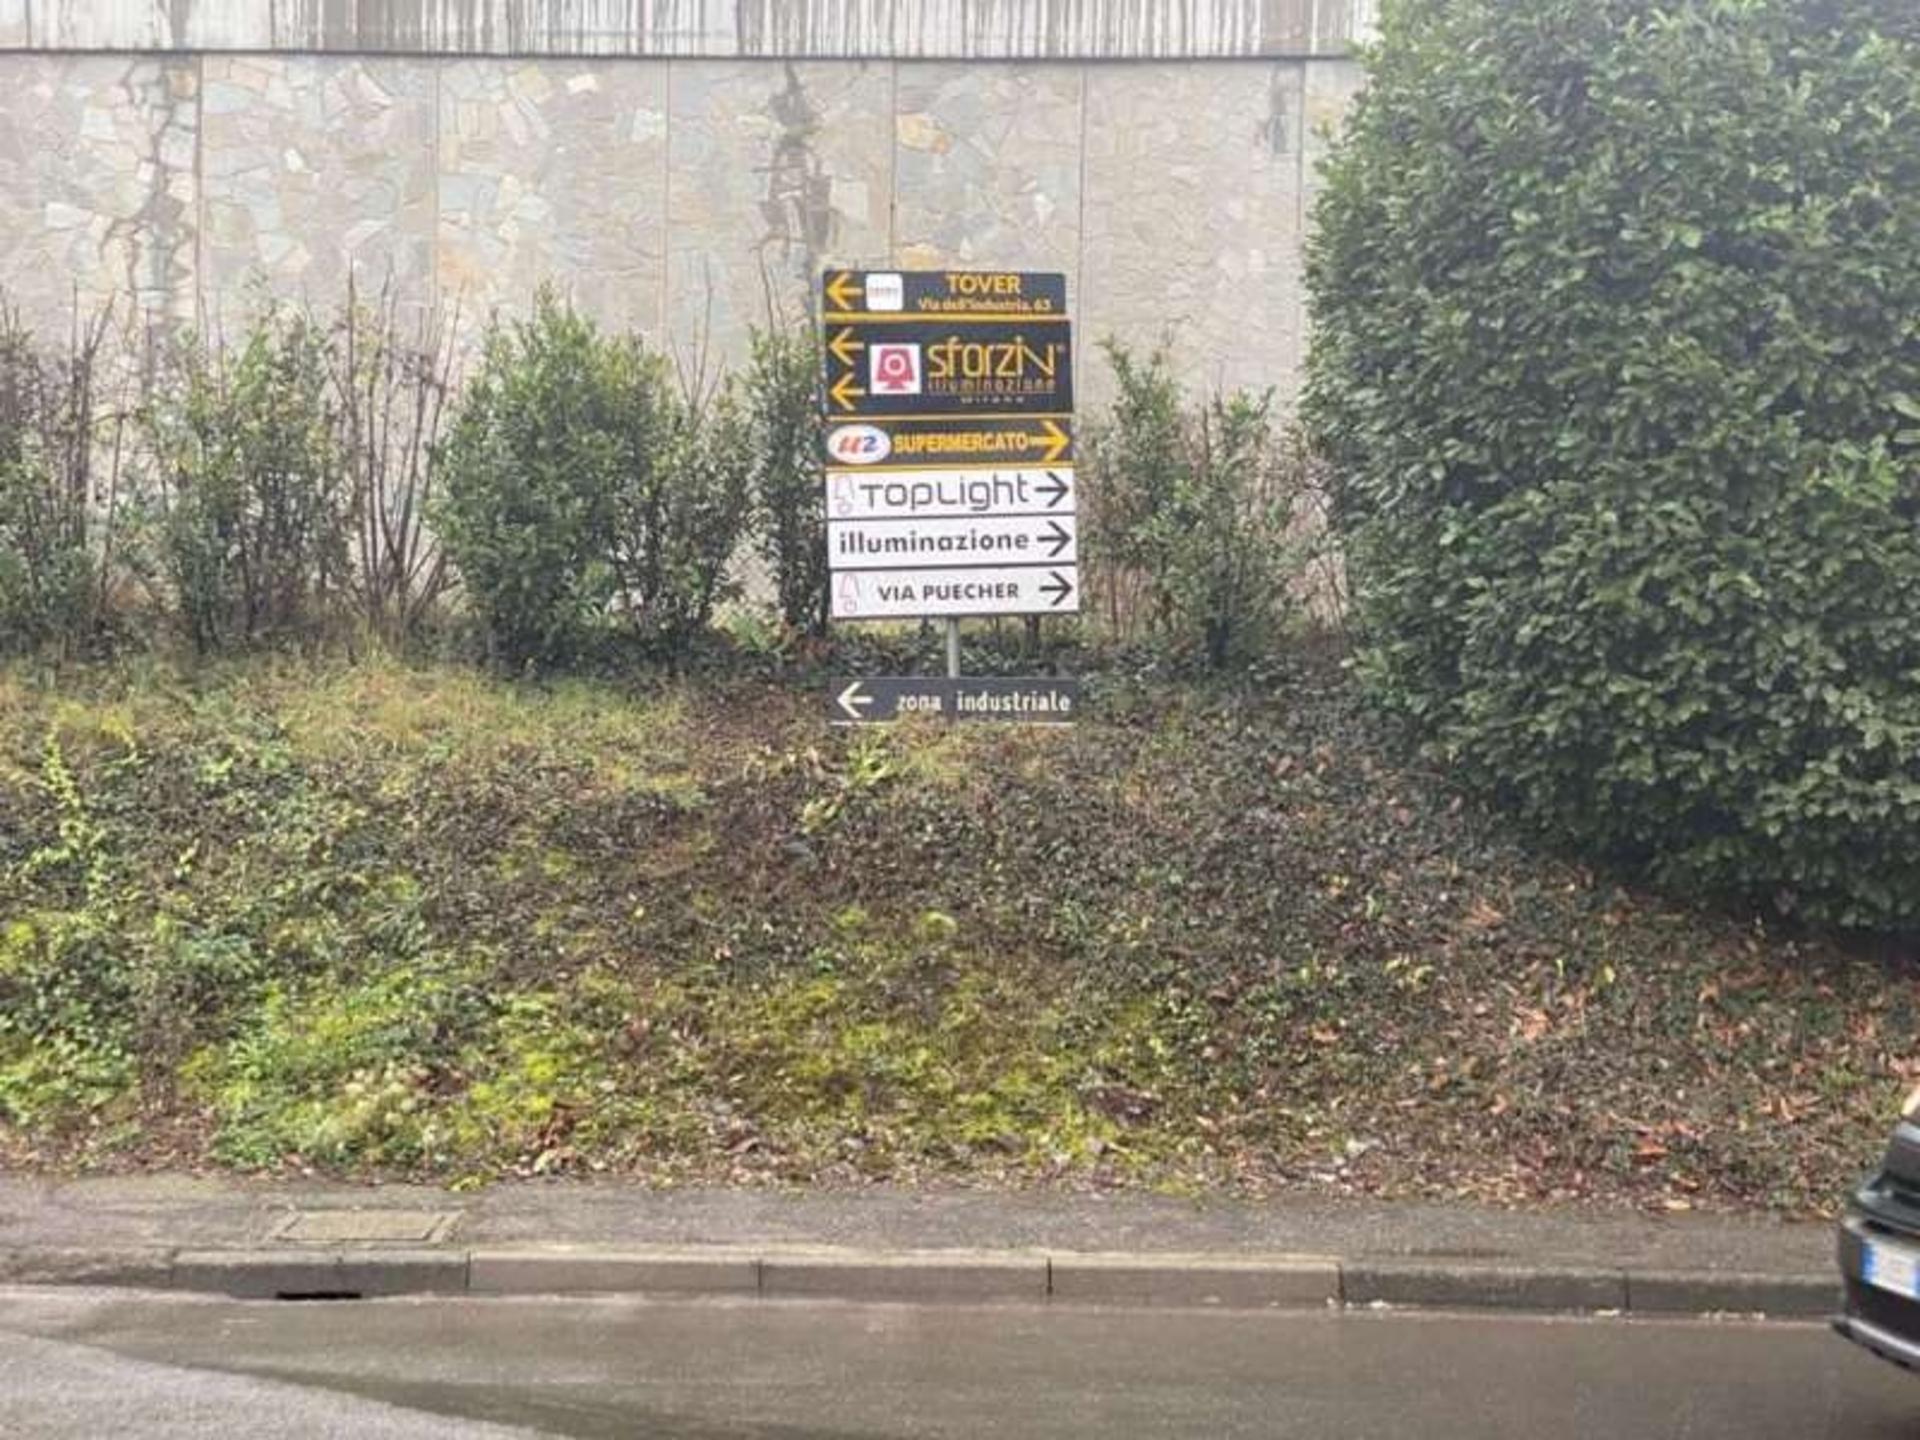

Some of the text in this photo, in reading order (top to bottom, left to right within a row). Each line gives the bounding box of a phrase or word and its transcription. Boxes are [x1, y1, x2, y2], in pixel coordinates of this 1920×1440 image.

[945, 274, 1021, 295] TOVER
[918, 298, 938, 311] Via
[893, 431, 1029, 454] SUPERMERCATO
[839, 529, 1030, 555] illuminazione
[878, 583, 1019, 602] VIA PUECHER
[896, 690, 1072, 712] zona industriale
